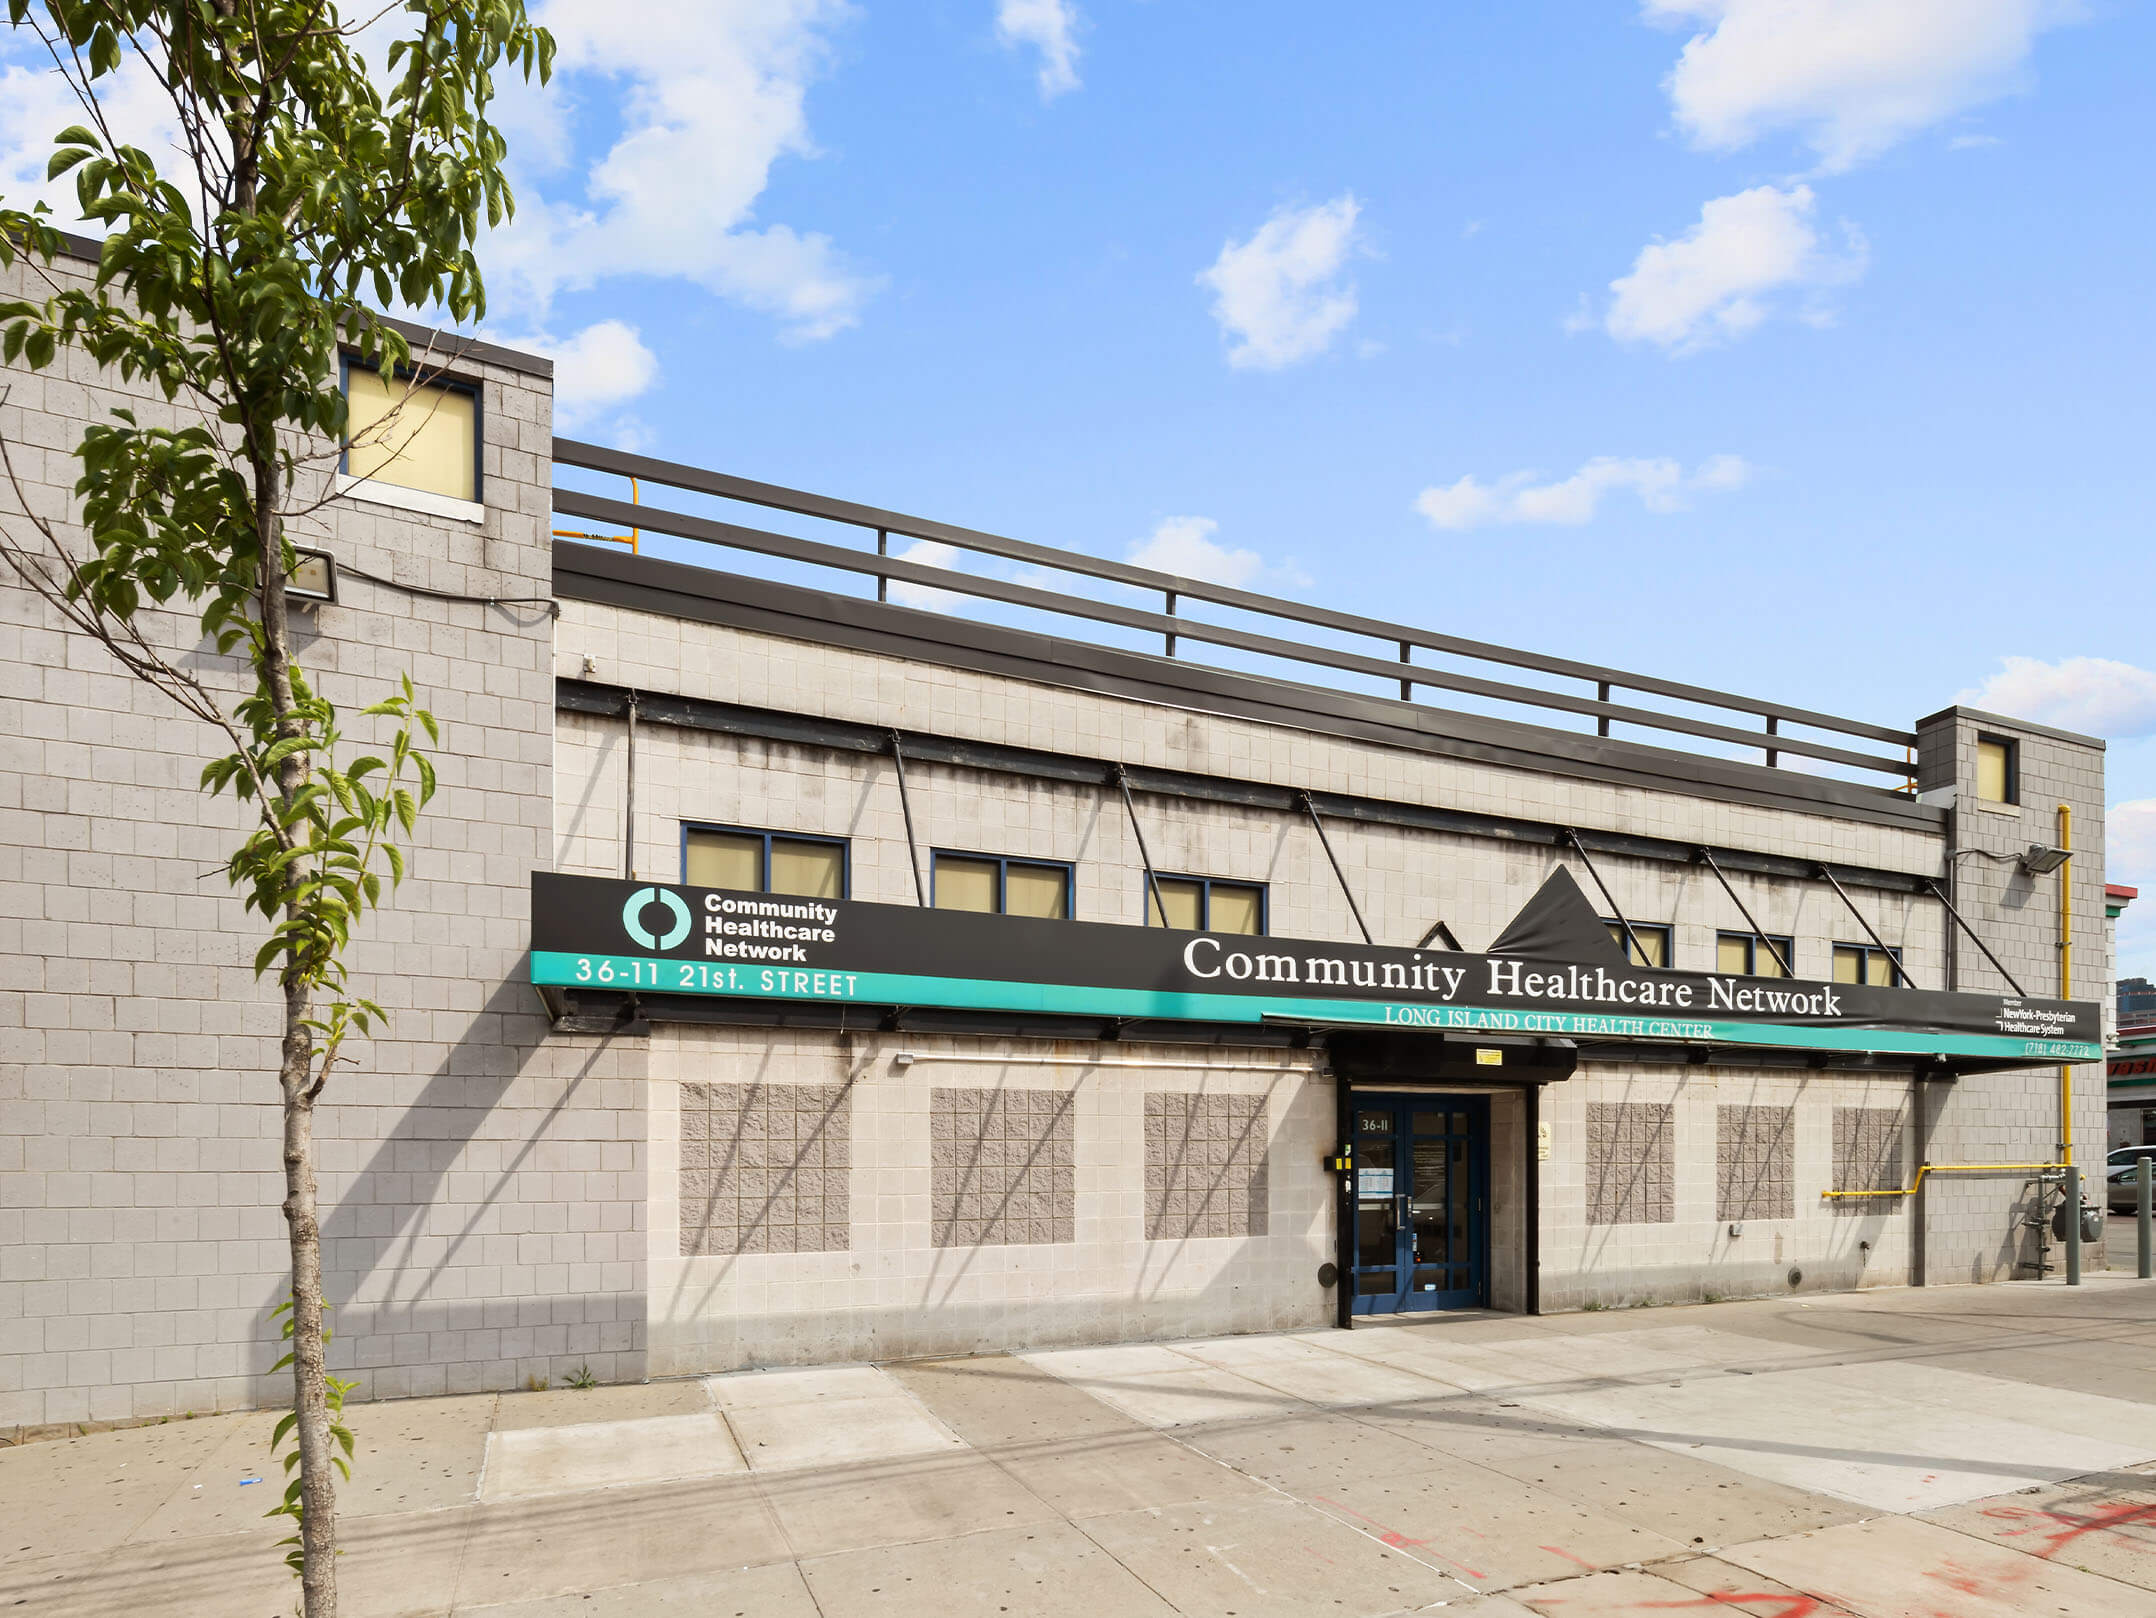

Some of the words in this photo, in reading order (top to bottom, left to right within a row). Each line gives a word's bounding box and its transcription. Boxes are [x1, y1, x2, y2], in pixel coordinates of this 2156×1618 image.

[704, 893, 838, 925] Community
[704, 915, 836, 943] Healthcare
[704, 937, 807, 962] Network
[575, 958, 658, 985] 36-11
[679, 965, 744, 991] 21st.
[760, 970, 858, 997] STREET
[1183, 937, 1466, 1001] Community
[1486, 959, 1693, 1008] Healthcare
[1706, 976, 1842, 1017] Network
[1384, 1006, 1441, 1026] LONG
[1447, 1009, 1519, 1030] ISLAND
[1524, 1014, 1567, 1032] CITY
[1572, 1017, 1644, 1036] HEALTH
[1649, 1021, 1714, 1039] CENTER
[2004, 1021, 2041, 1034] Healthcare
[2041, 1023, 2065, 1038] System
[2025, 1042, 2047, 1056] (718)
[1362, 1119, 1388, 1131] 36-11
